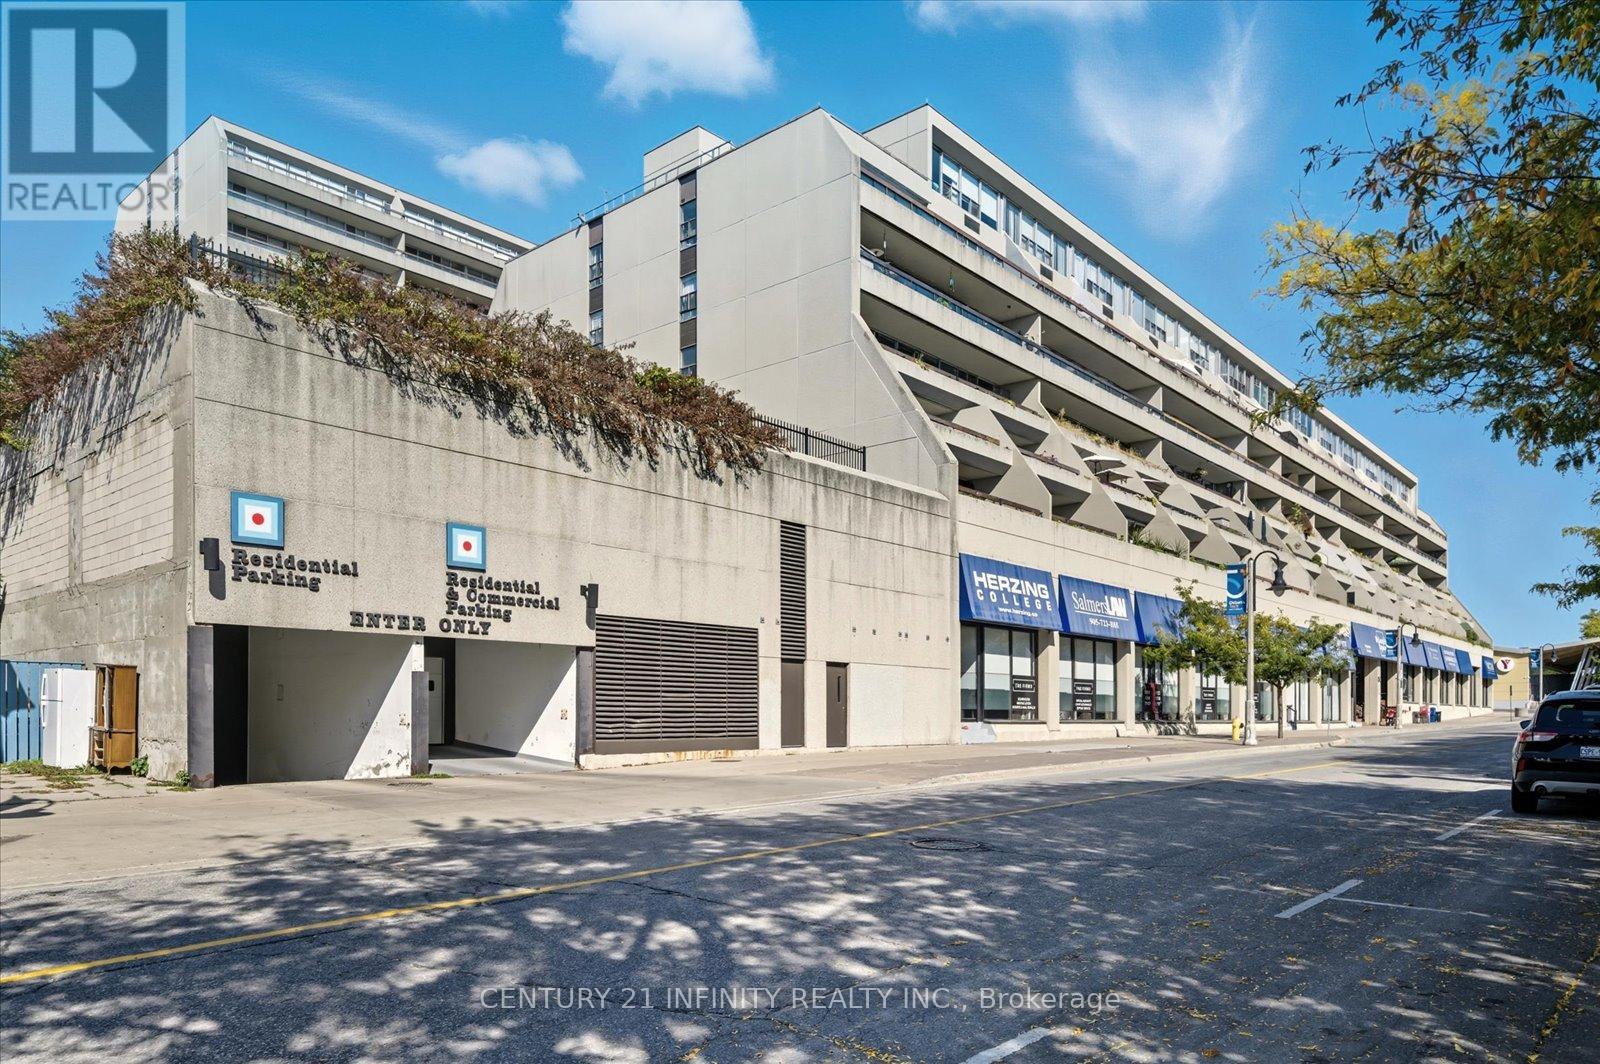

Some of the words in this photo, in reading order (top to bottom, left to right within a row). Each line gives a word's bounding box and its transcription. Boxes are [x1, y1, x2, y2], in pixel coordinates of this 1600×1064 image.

[231, 548, 359, 577] Residential
[231, 565, 321, 592] Parking
[446, 572, 540, 595] Residential
[973, 570, 1050, 600] HERZING
[446, 587, 459, 601] &
[467, 589, 560, 611] Commercial
[976, 589, 1053, 612] COLLEGE
[350, 611, 426, 632] ENTER
[439, 618, 492, 636] ONLY
[446, 601, 512, 622] Parking
